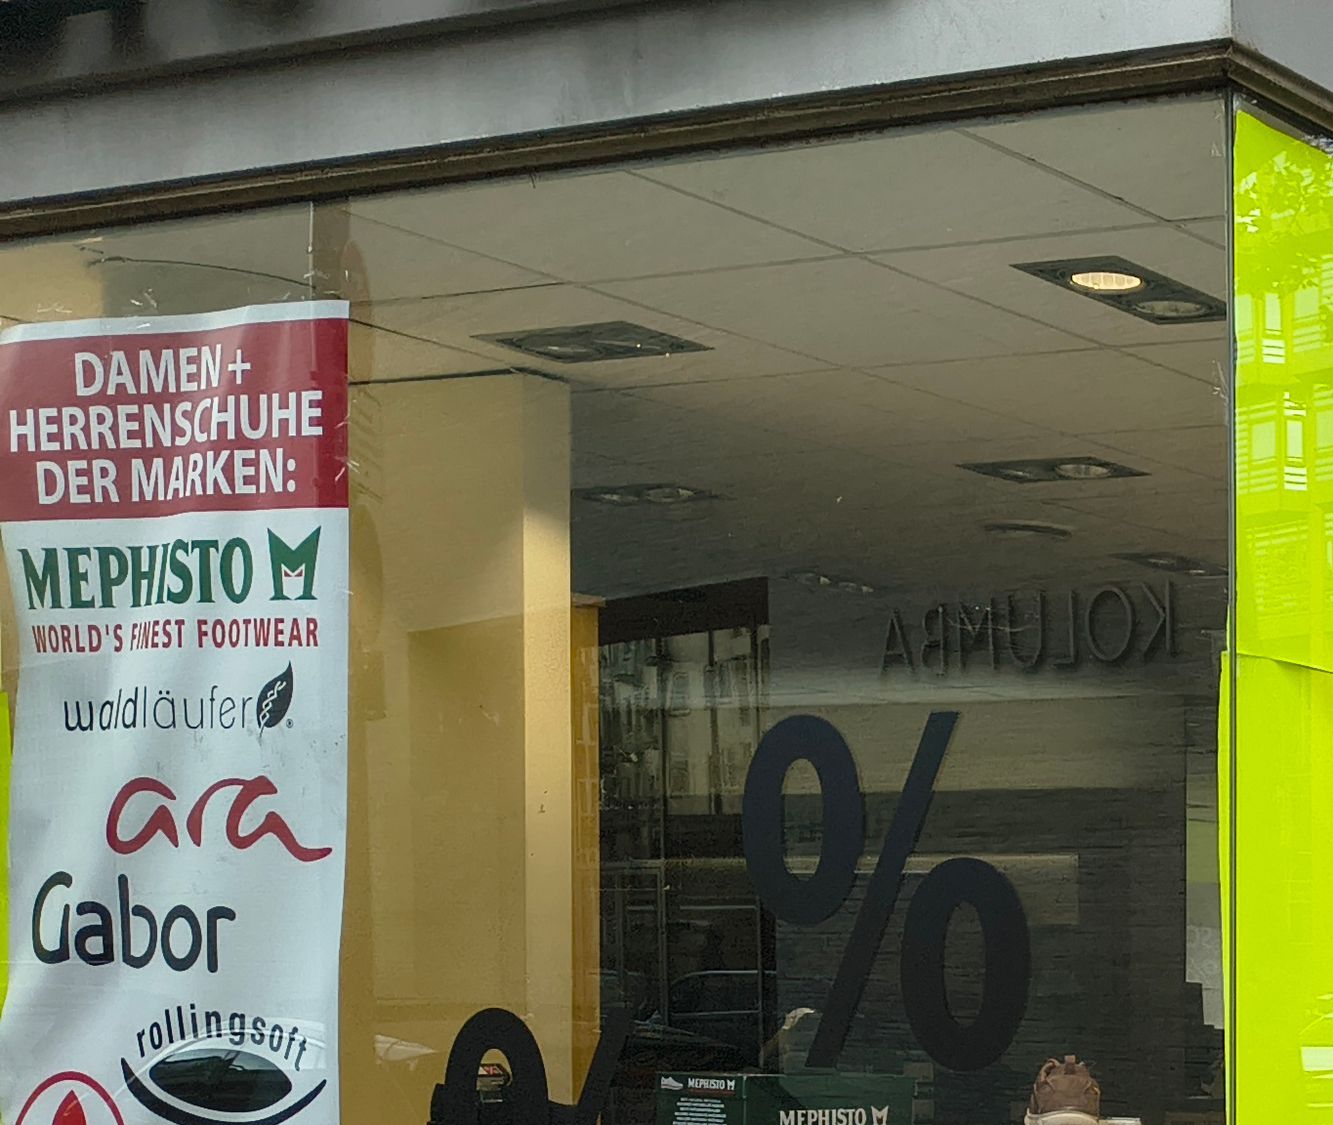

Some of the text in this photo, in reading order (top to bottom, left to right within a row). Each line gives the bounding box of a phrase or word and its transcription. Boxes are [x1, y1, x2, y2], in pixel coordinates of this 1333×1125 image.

[10, 391, 323, 452] HERRENSCHUHE
[36, 448, 296, 504] DER MARKEN:
[18, 537, 253, 609] MEPHISTO
[32, 617, 318, 653] WORLD'S FINEST FOOTWEAR
[106, 776, 332, 862] ara
[32, 871, 236, 973] Gabor
[136, 1004, 308, 1072] rollingsoft
[688, 1077, 725, 1090] MEPHISTO
